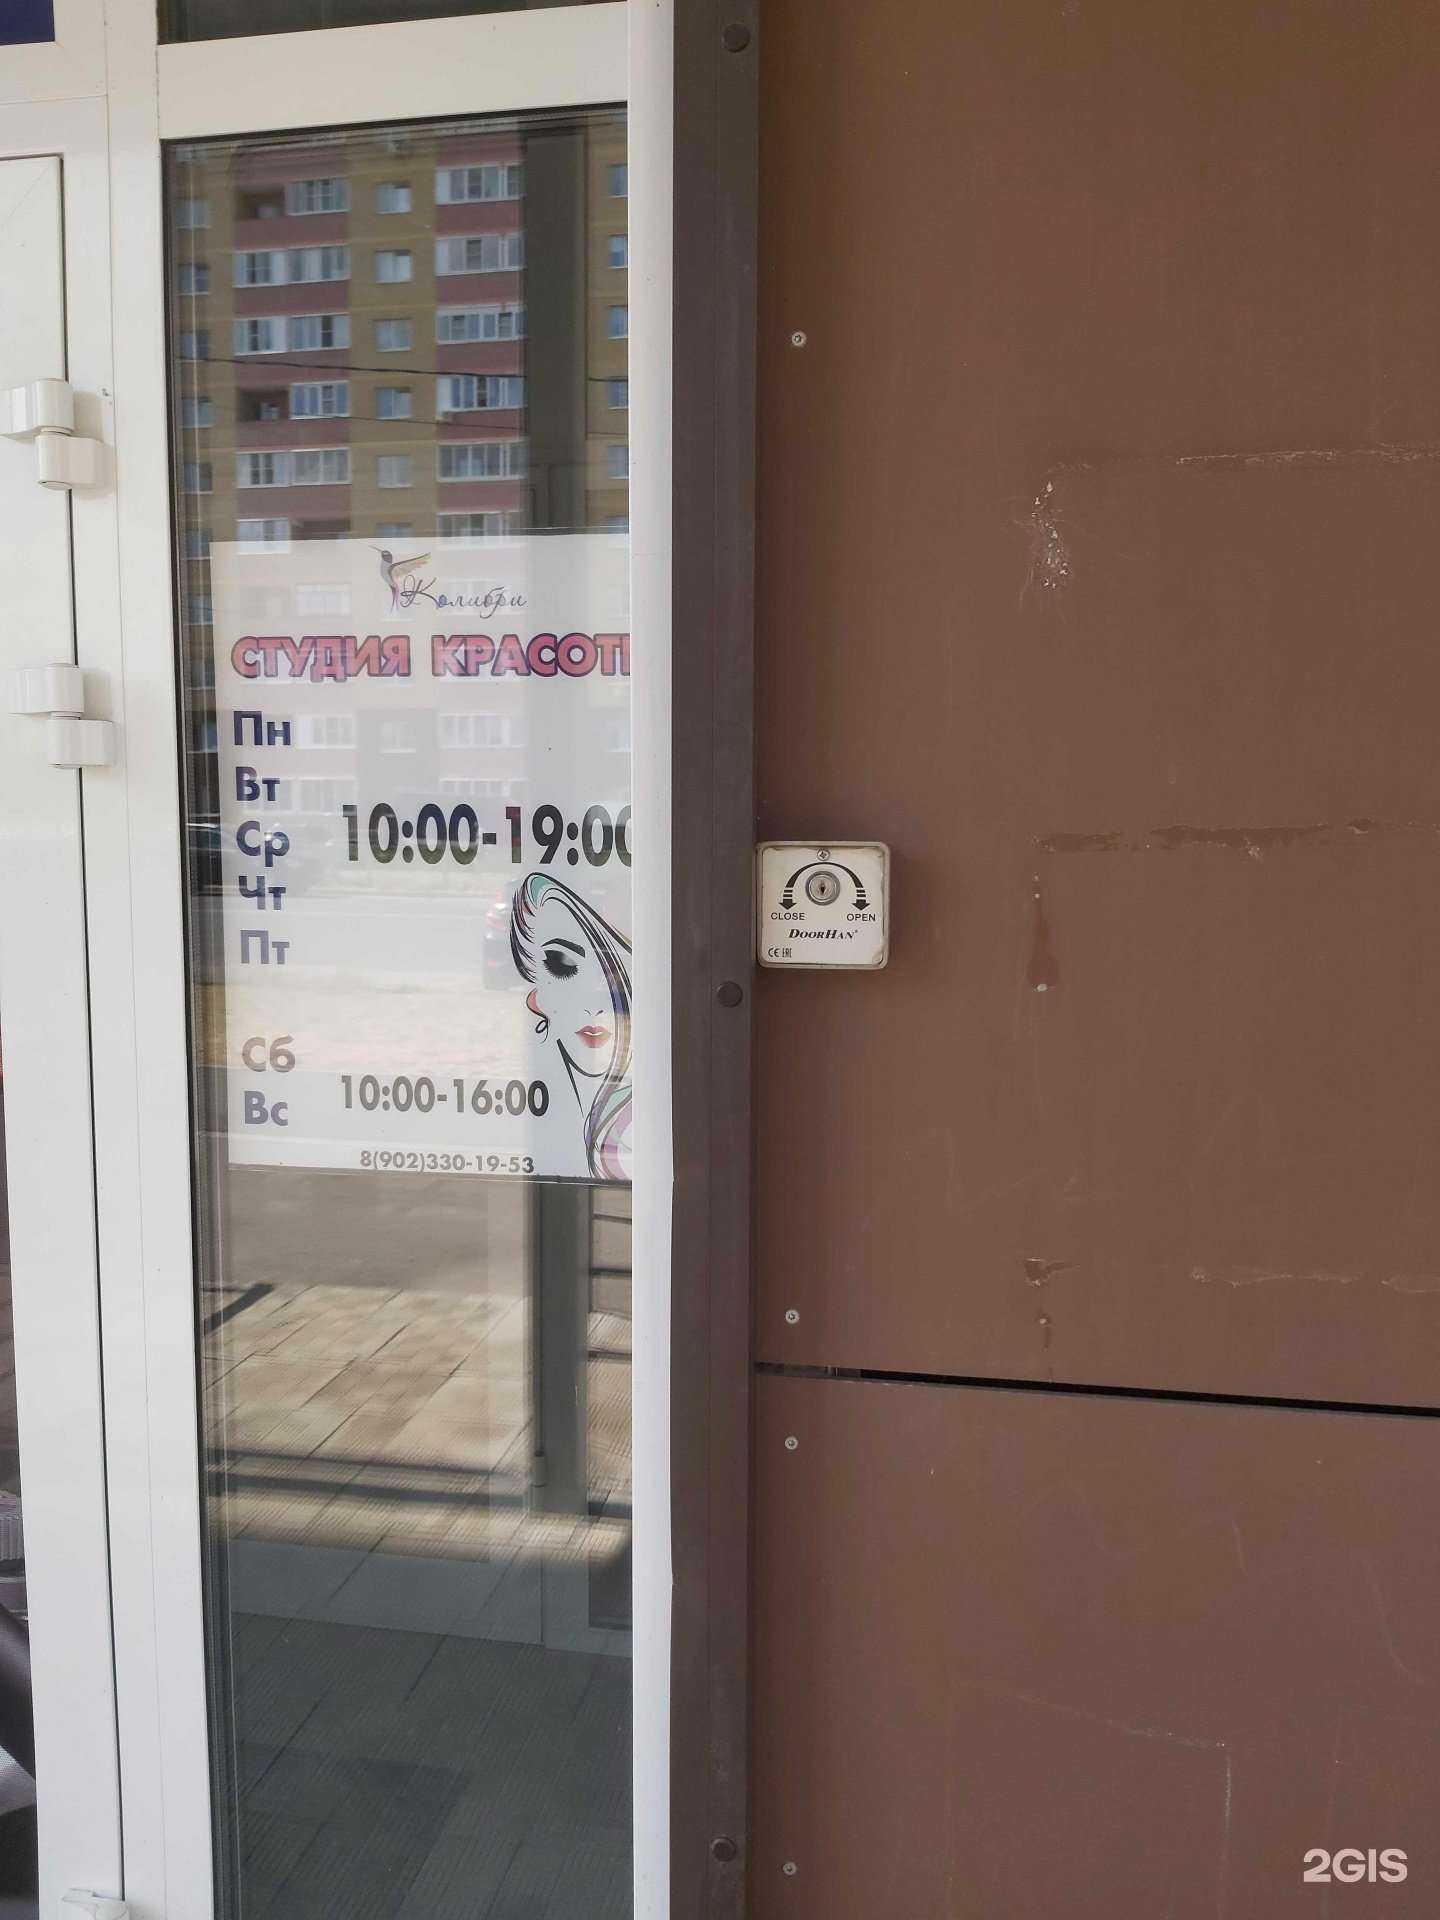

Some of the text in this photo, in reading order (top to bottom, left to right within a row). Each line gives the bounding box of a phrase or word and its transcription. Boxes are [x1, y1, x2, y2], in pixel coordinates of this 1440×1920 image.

[400, 575, 527, 618] Колибри
[231, 635, 411, 683] СТУДИЯ
[233, 711, 291, 746] Пн
[235, 766, 280, 802] Вт
[236, 821, 290, 867] Ср
[238, 876, 286, 911] Чт
[770, 912, 806, 921] CLOSE
[846, 913, 876, 922] OPEN
[240, 930, 290, 965] Пт
[242, 1034, 296, 1073] Сб
[244, 1091, 289, 1127] Вс
[341, 1075, 549, 1117] 10:00-16:00
[360, 1150, 535, 1174] 8(902)330-19-53
